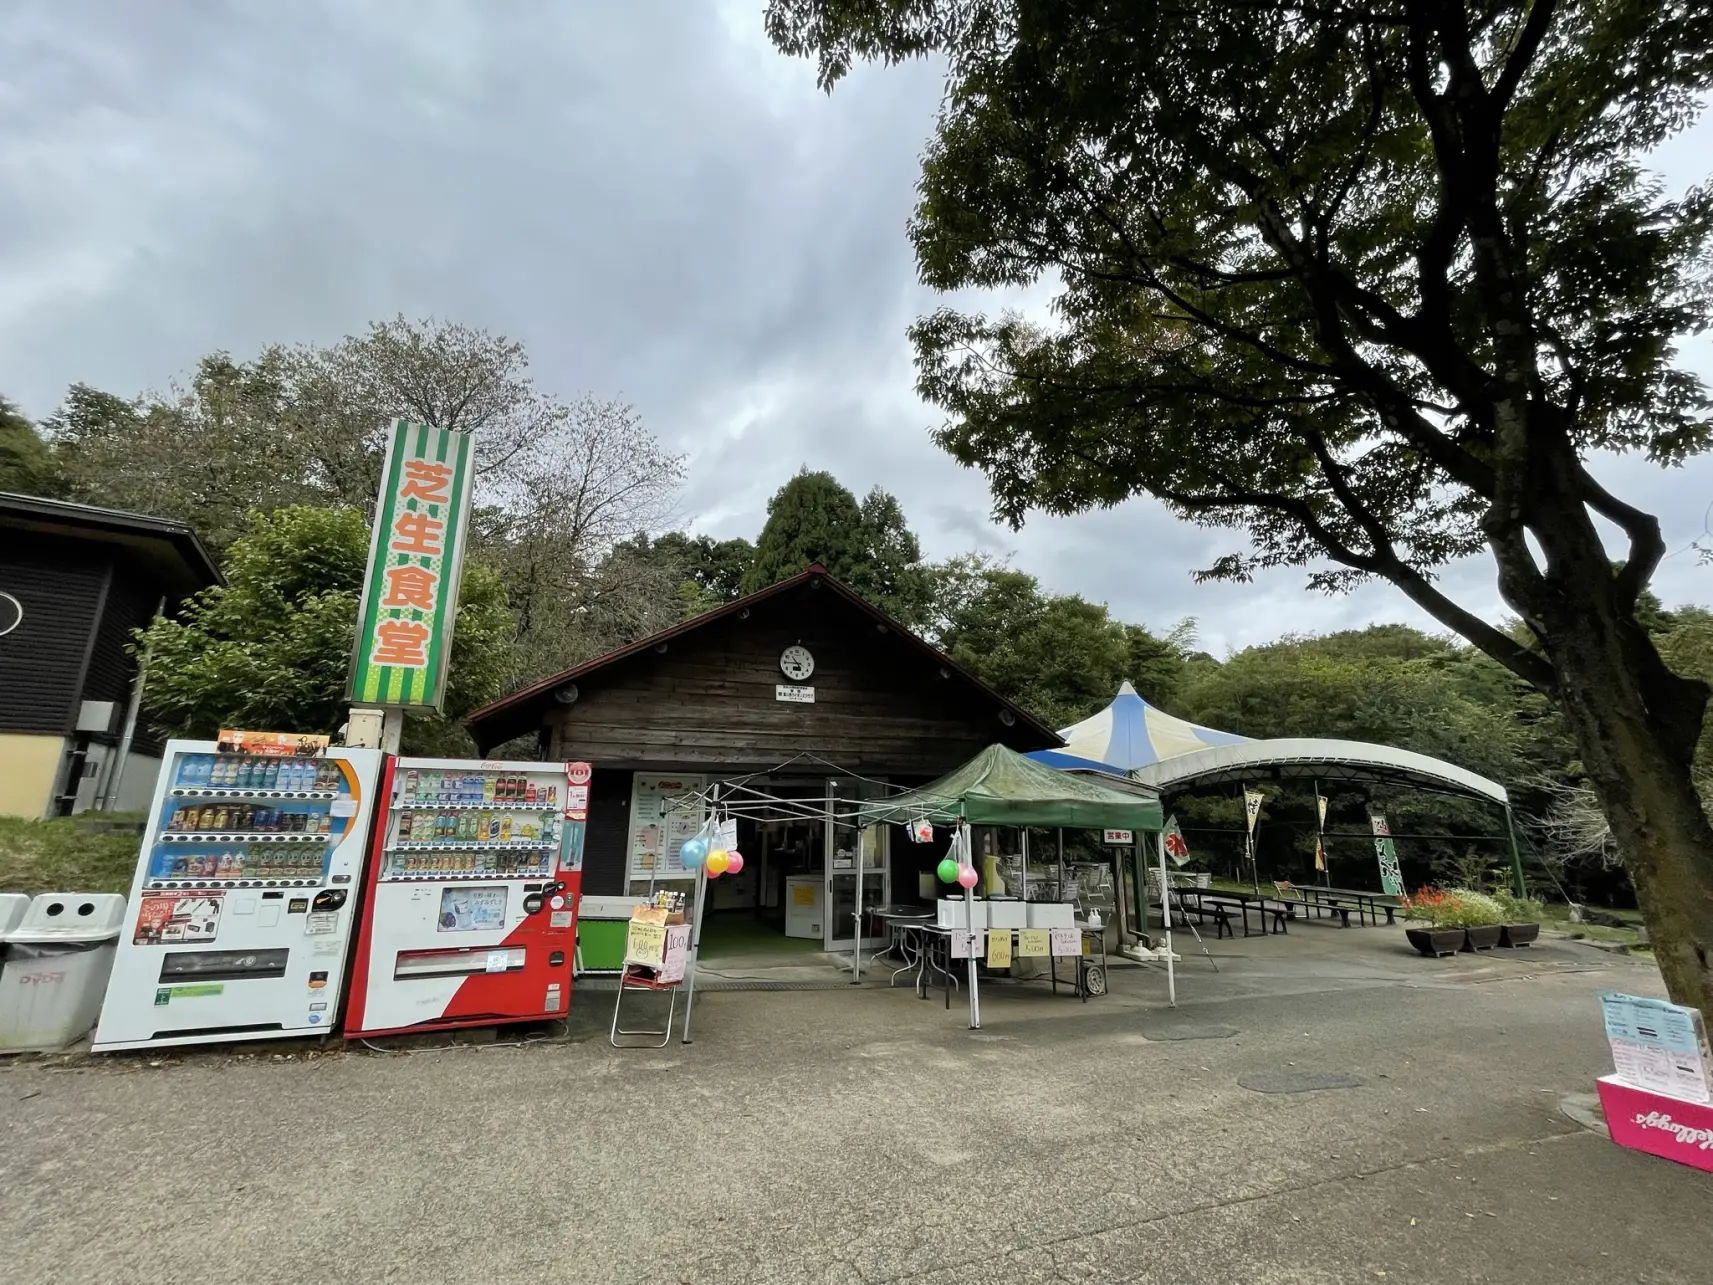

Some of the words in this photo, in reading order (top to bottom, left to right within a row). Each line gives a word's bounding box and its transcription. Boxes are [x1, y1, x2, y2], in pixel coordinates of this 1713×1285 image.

[373, 459, 453, 666] 芝生食堂
[1107, 831, 1130, 840] 営業中
